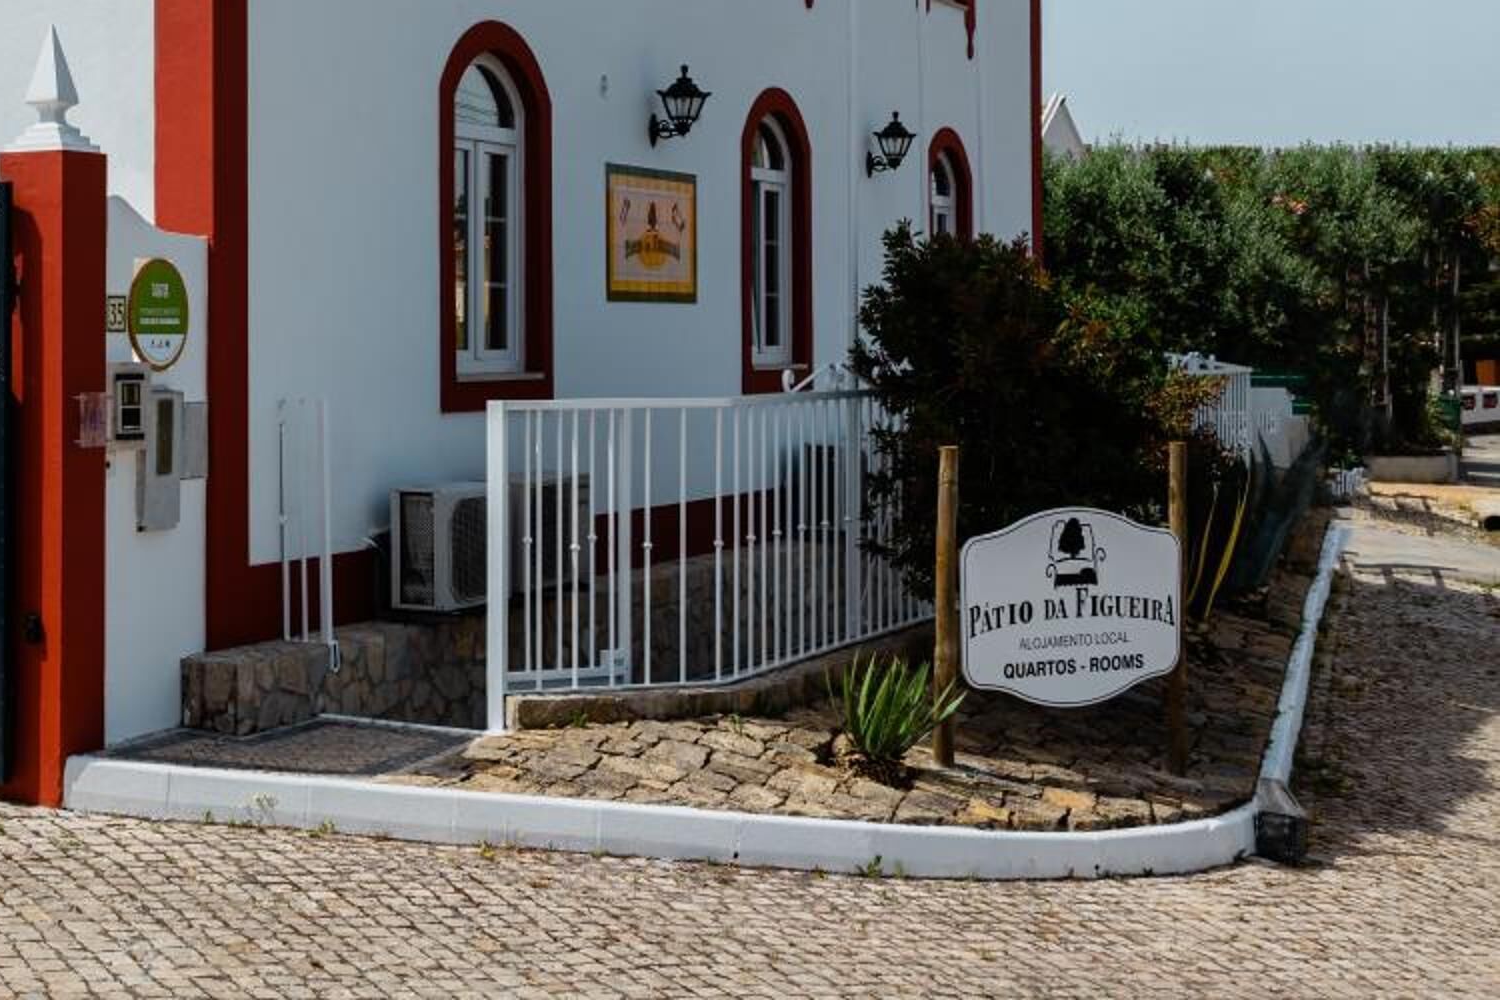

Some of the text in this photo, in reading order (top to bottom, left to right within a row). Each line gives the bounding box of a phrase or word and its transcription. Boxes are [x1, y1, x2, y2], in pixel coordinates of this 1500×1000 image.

[107, 303, 123, 326] 35
[969, 587, 1175, 639] PÁTIO DA FIGUEIRA
[1018, 631, 1130, 650] ALOJAMENTO LOCAL
[1003, 659, 1077, 679] QUARTOS
[1089, 653, 1144, 672] ROOMS
